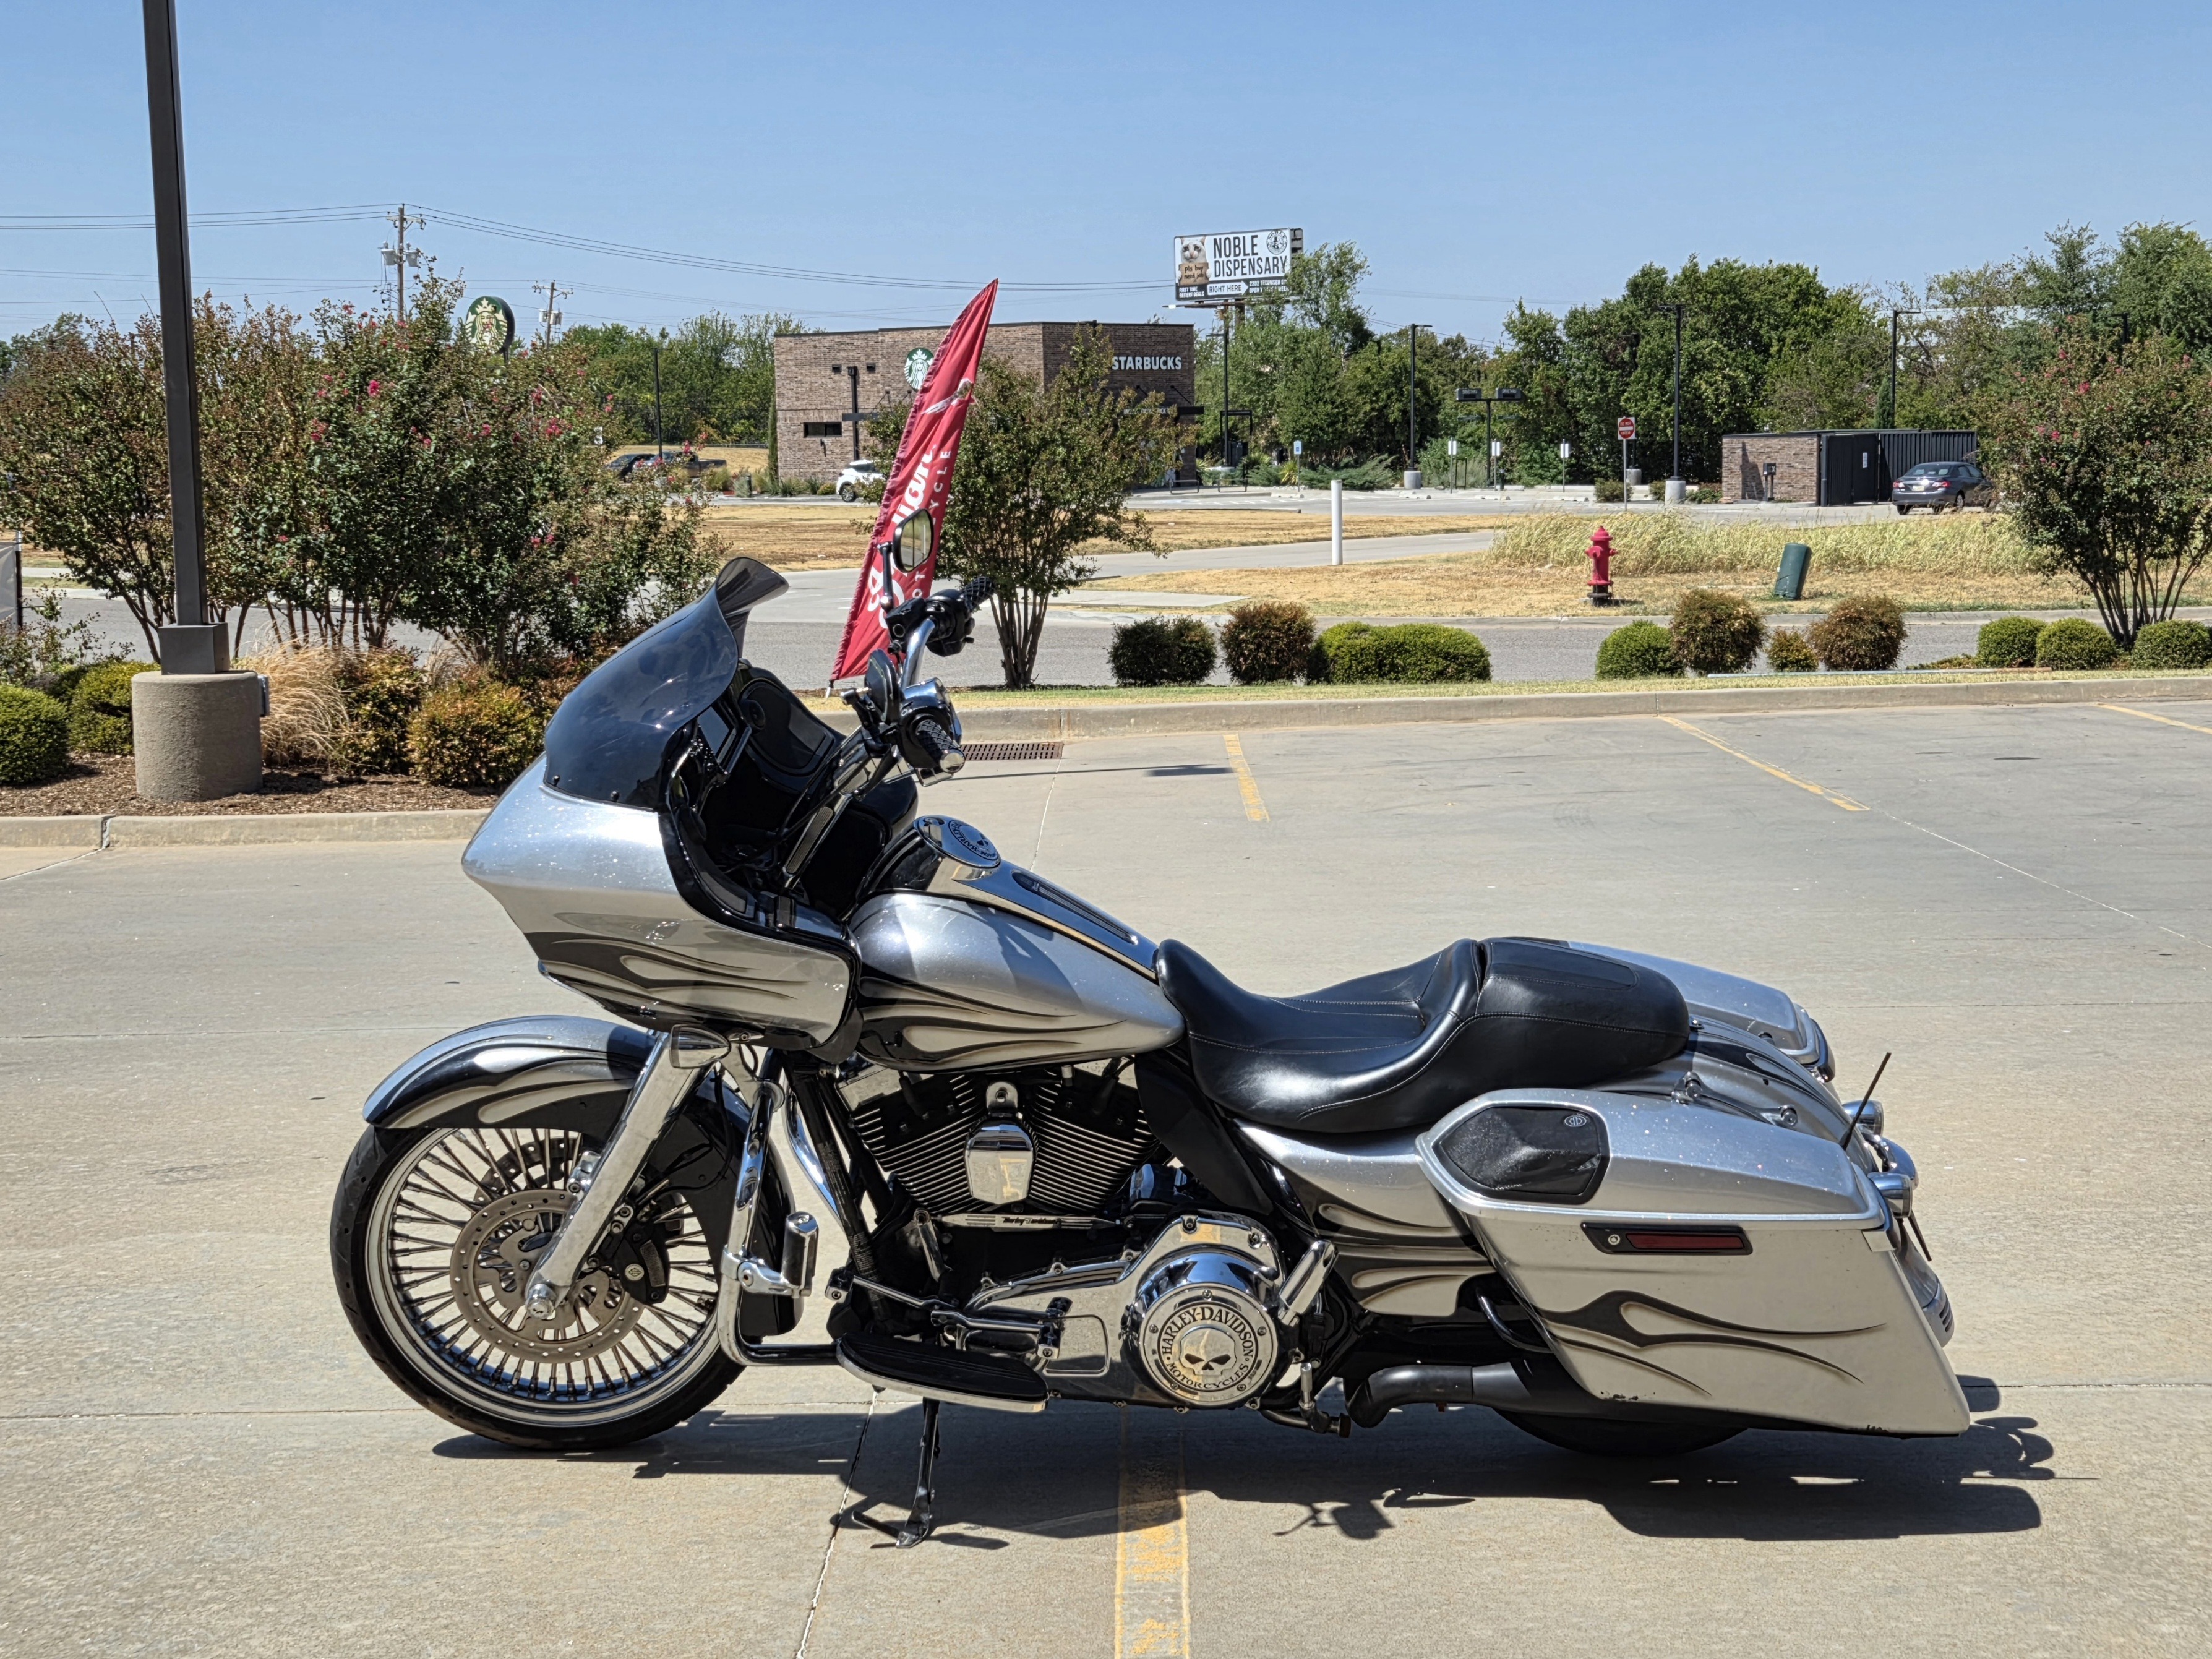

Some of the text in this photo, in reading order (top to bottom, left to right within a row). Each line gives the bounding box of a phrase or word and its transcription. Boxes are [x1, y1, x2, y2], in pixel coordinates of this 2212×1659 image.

[1214, 235, 1258, 259] NOBLE
[1185, 265, 1193, 273] pls
[1214, 255, 1287, 278] DISPENSARY
[1112, 356, 1182, 370] STARBUCKS
[1162, 1306, 1254, 1358] HARLEY-DAVIDSON
[1167, 1363, 1249, 1389] MOTORCYCLES
